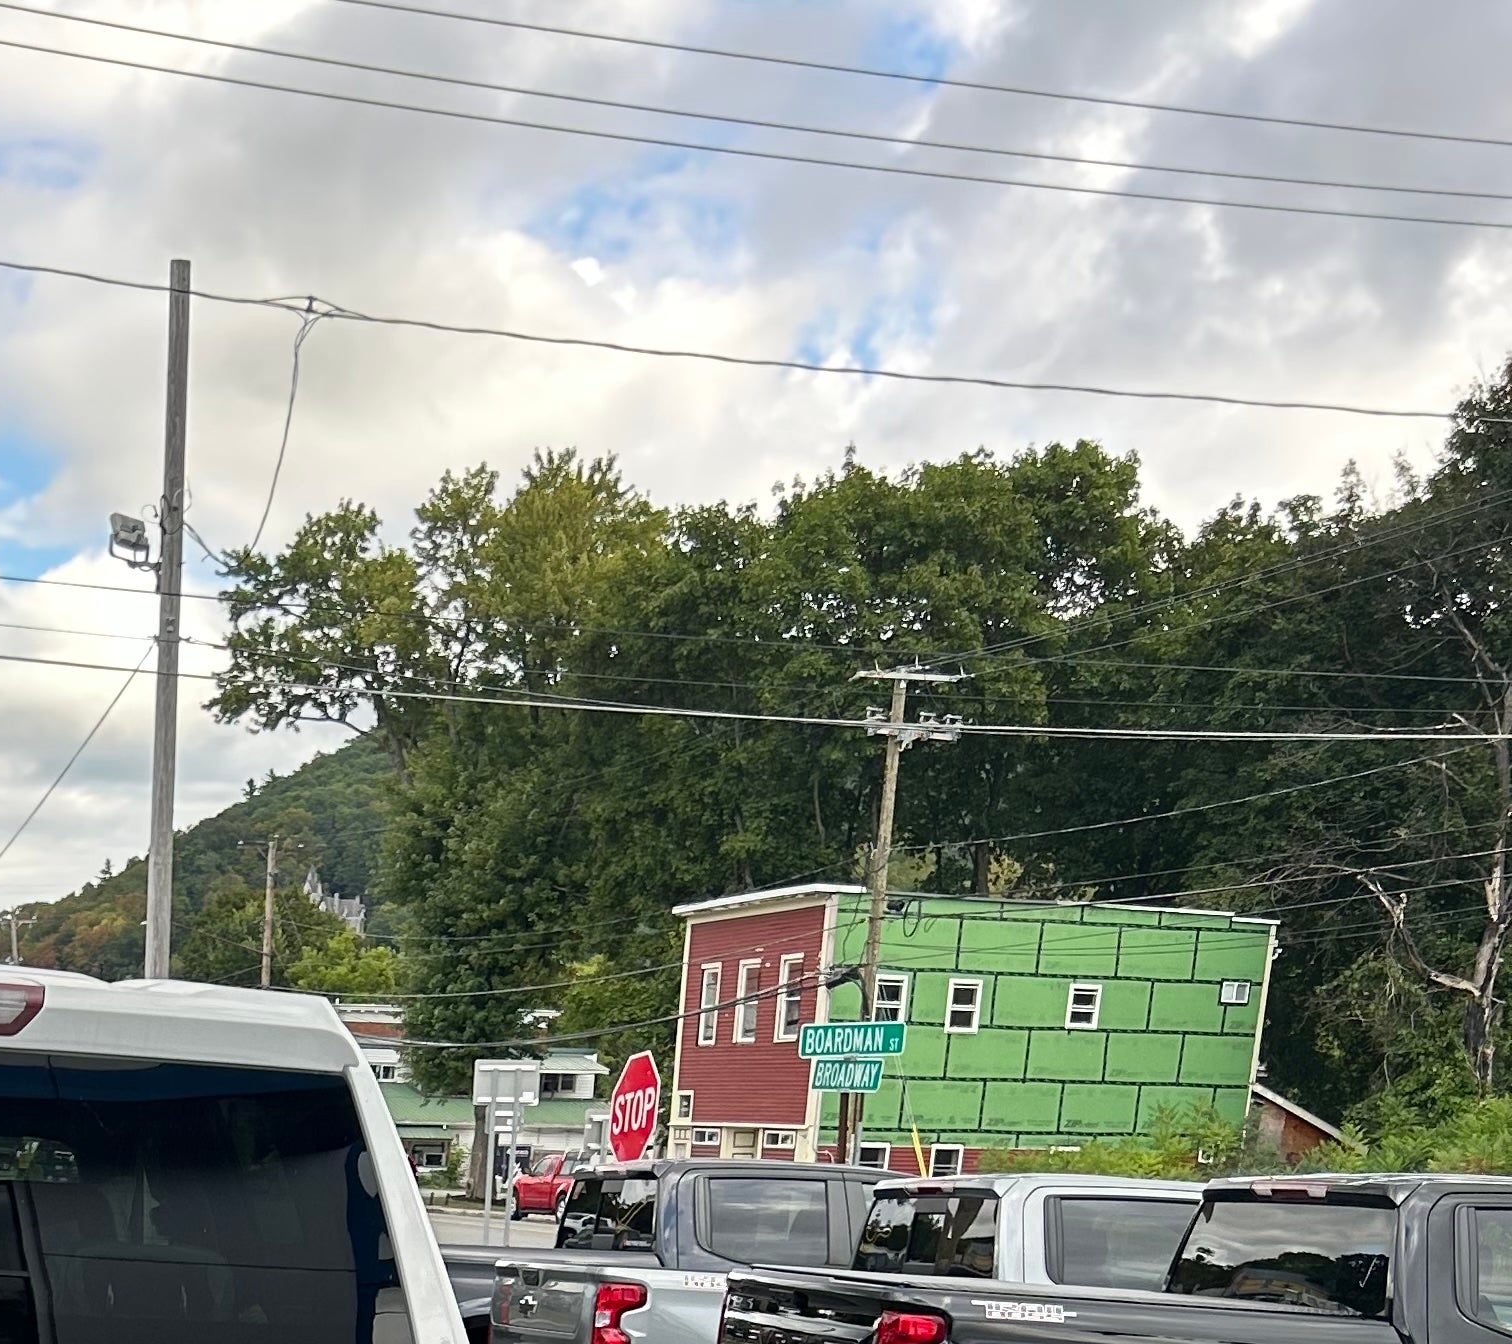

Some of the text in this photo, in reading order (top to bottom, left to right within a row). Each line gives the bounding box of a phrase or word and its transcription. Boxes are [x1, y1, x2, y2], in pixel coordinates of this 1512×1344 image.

[805, 1027, 899, 1053] BOARDMAN ST
[815, 1063, 879, 1087] BROADWAY
[612, 1087, 655, 1135] STOP
